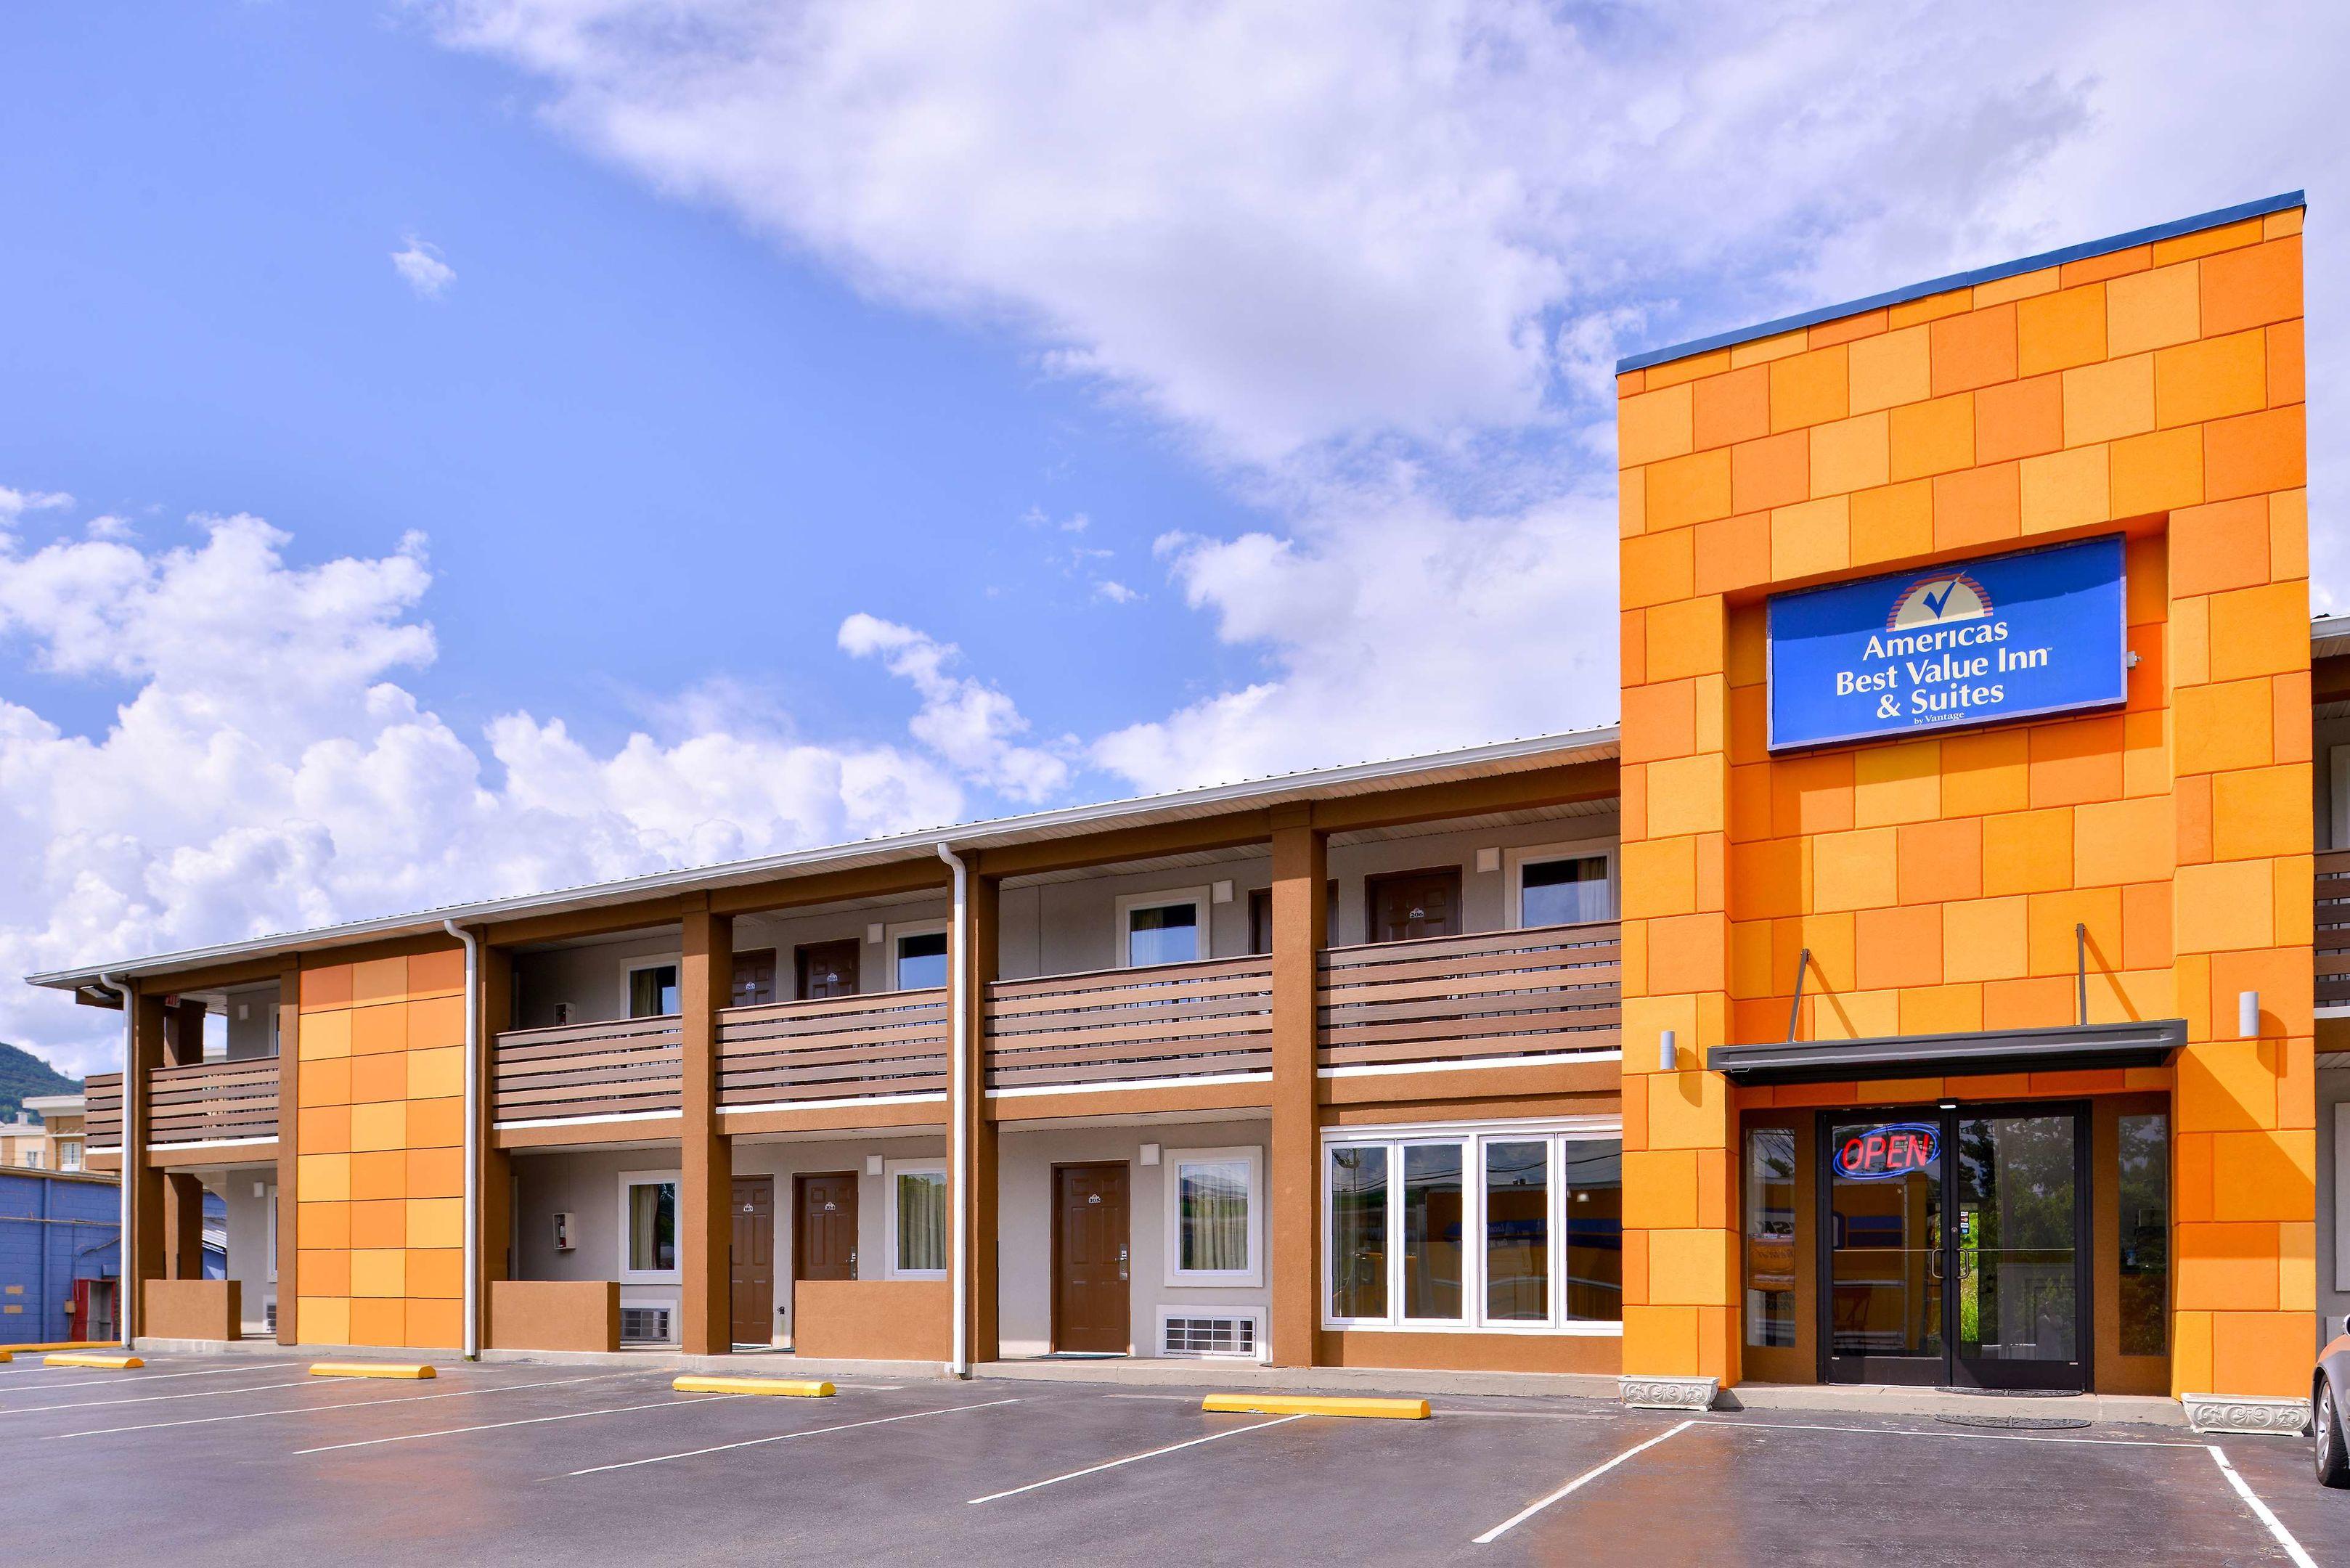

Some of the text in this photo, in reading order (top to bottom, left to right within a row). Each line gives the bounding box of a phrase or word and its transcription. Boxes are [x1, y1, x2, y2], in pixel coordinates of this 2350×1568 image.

[1862, 621, 2008, 661] Americas
[1836, 648, 2047, 695] Best Value Inn
[1877, 682, 2004, 719] & Suites
[1925, 712, 1965, 723] Vantage
[1842, 1134, 1930, 1170] OPEN
